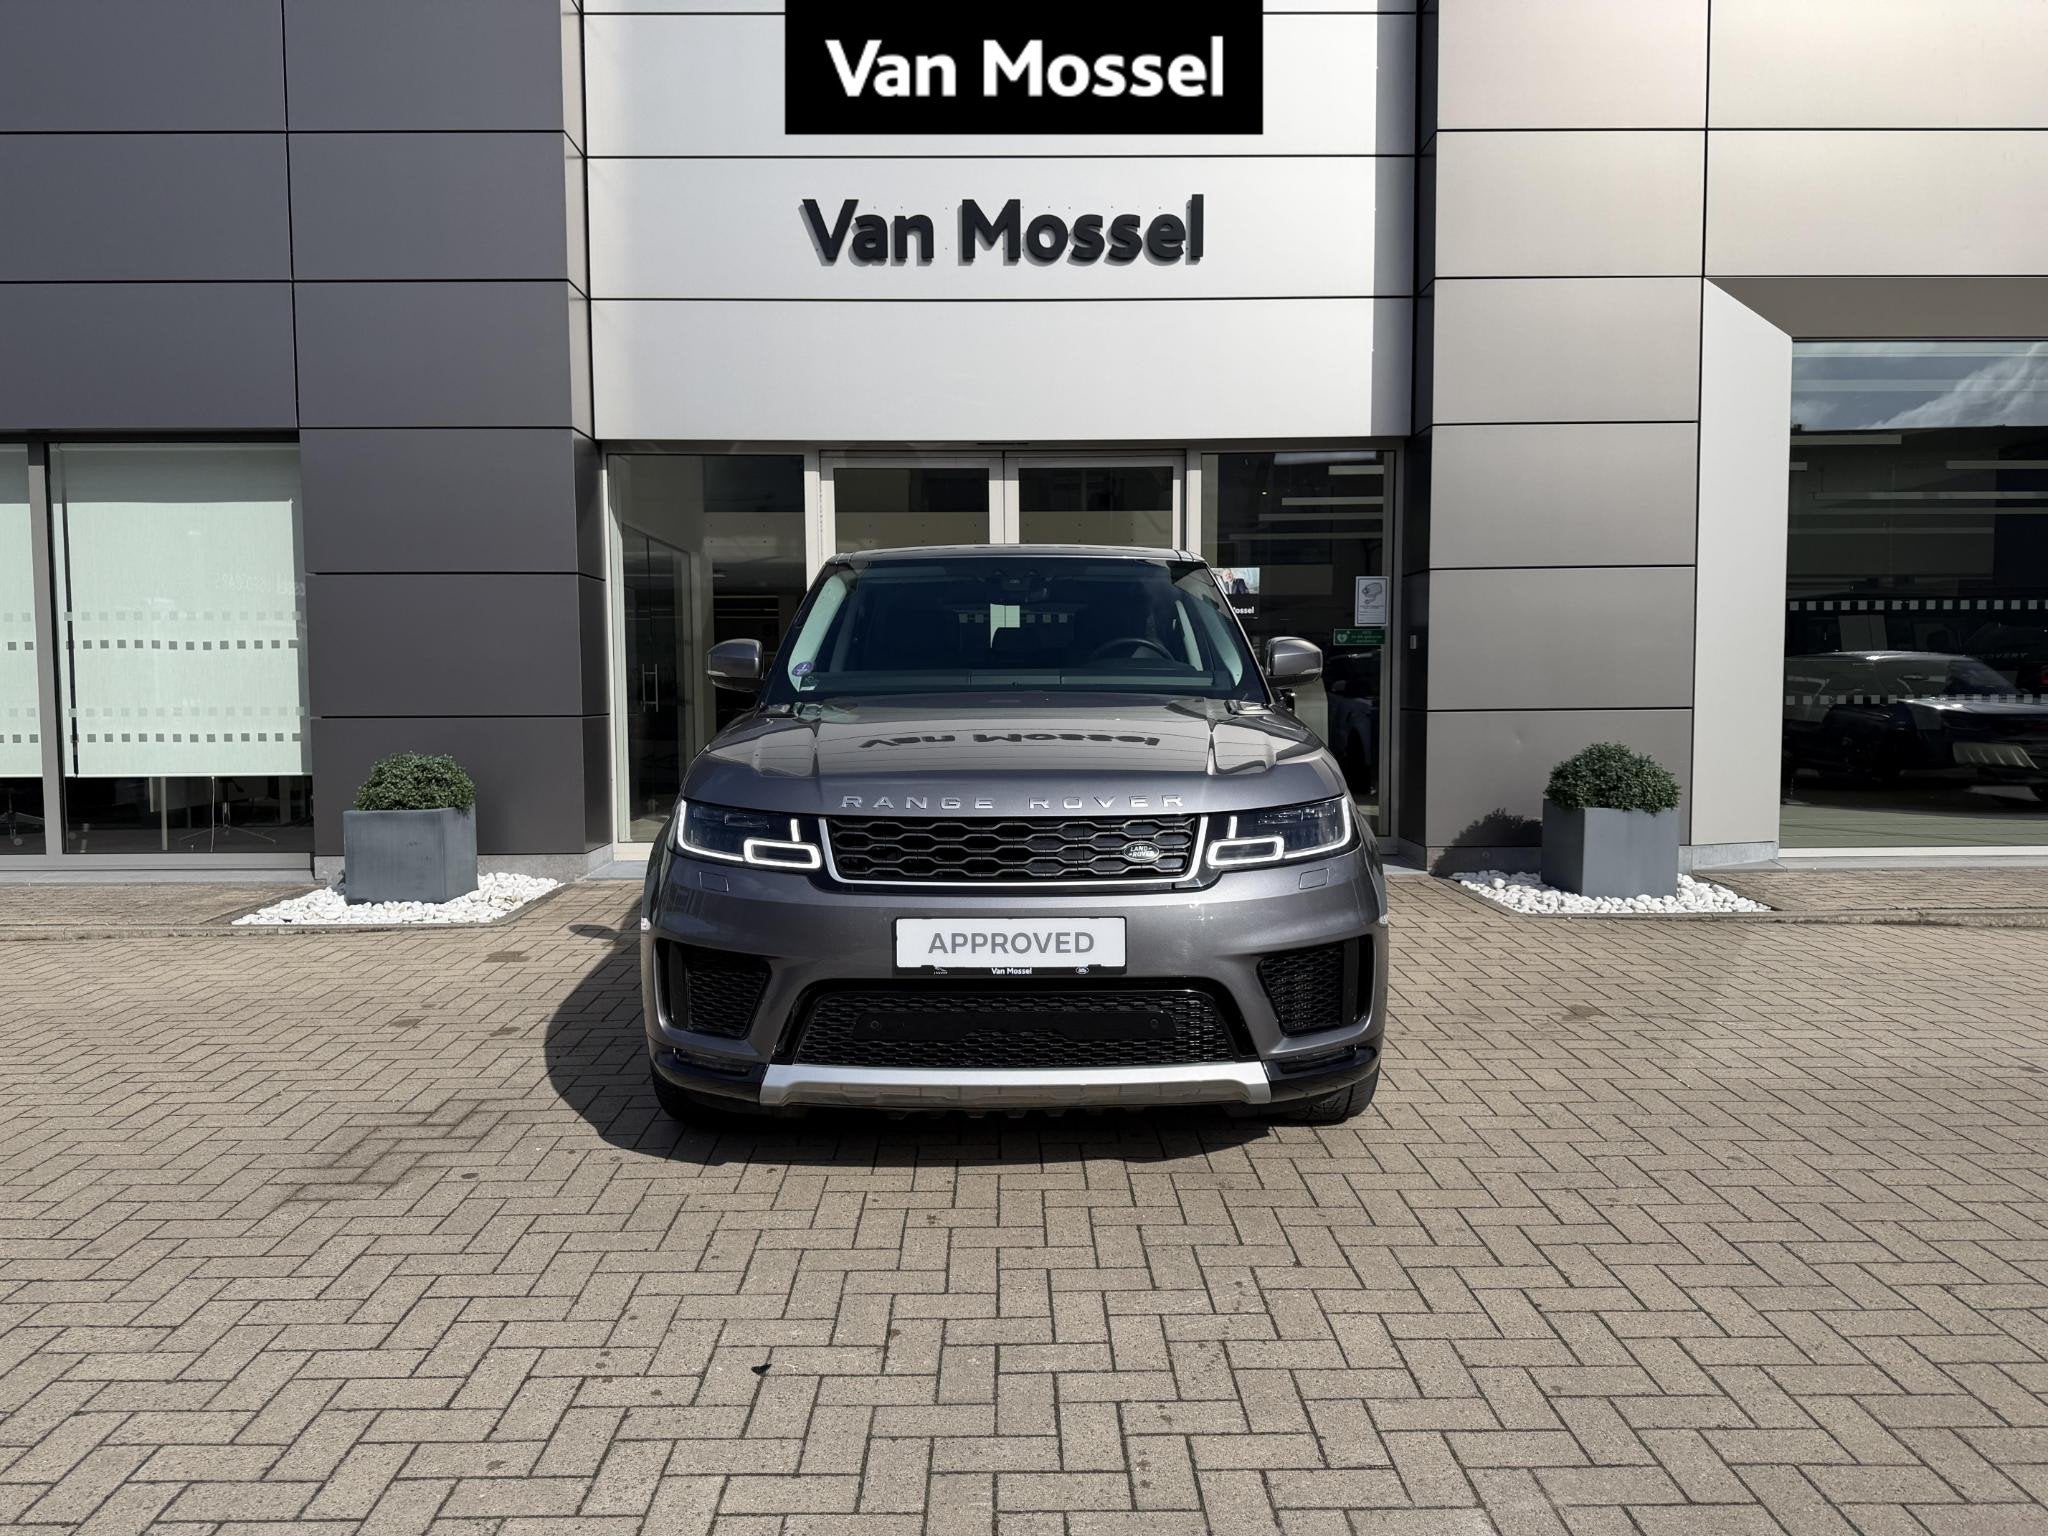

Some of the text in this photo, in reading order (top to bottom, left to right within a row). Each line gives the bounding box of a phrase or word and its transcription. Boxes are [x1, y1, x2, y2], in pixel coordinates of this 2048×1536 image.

[801, 193, 1205, 262] Van Mossel
[1233, 606, 1255, 614] ossel
[841, 794, 1184, 810] RANGE ROVER
[928, 932, 1095, 954] APPROVED
[991, 967, 1033, 975] Van Mossel
